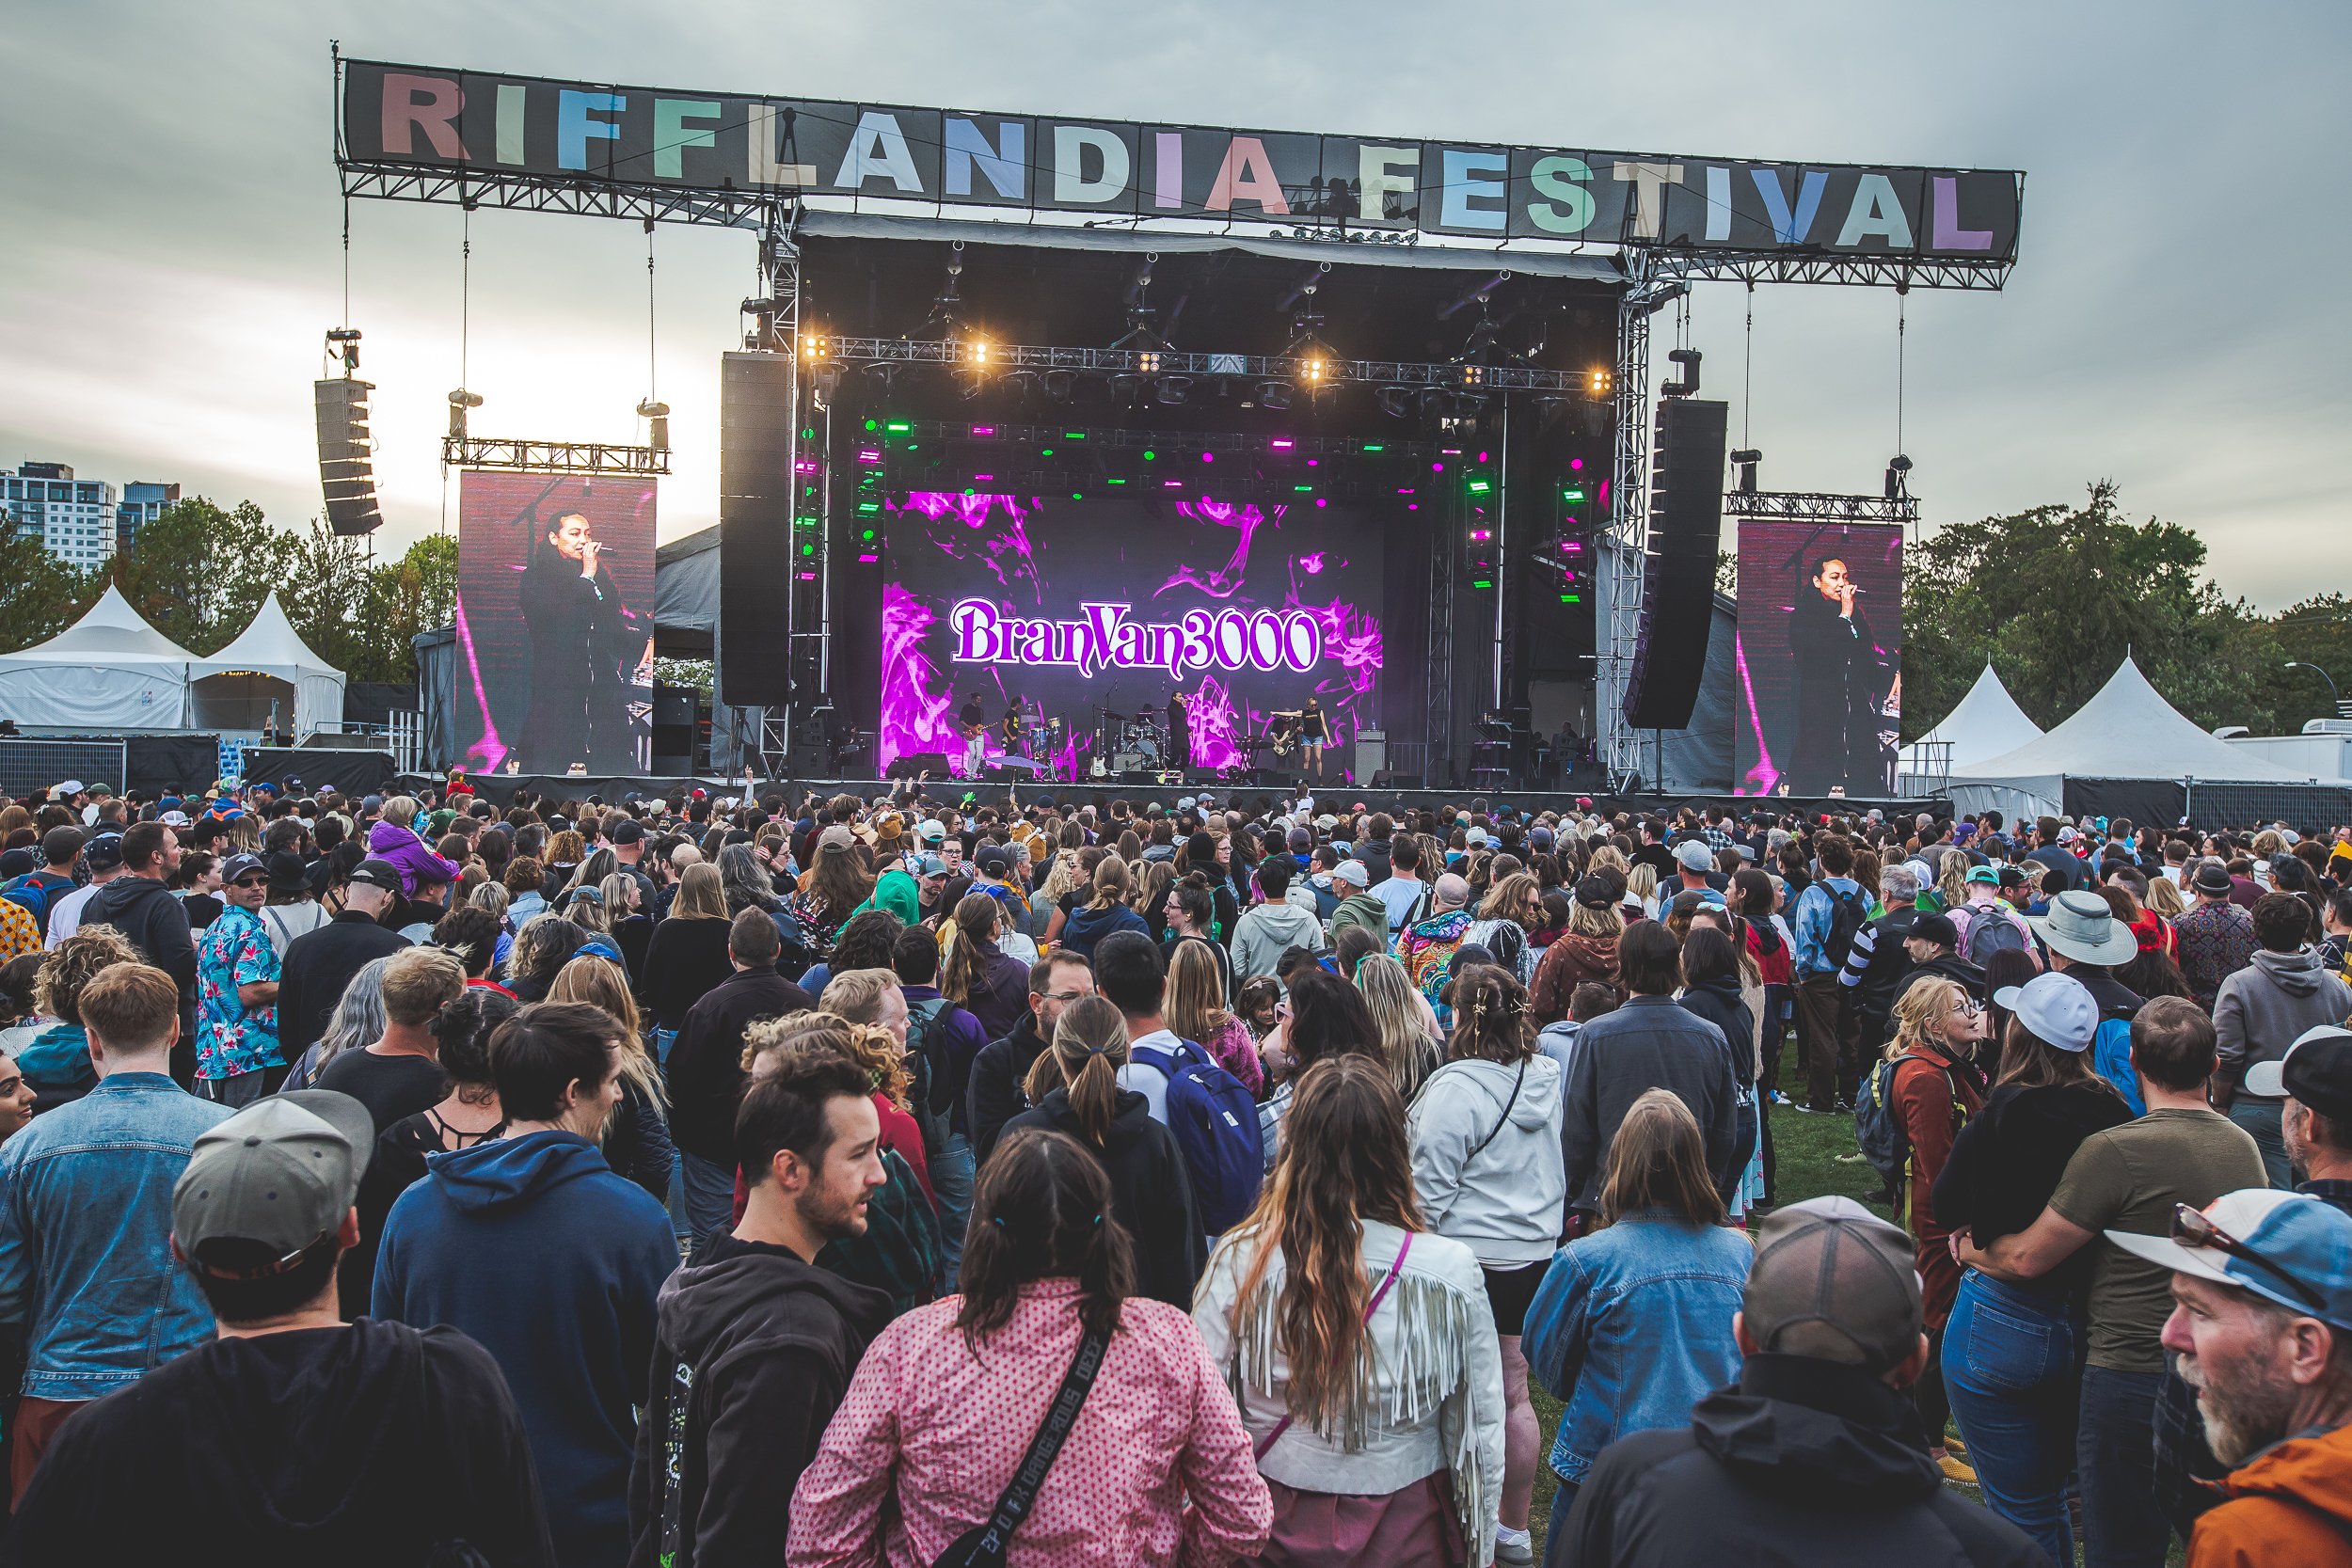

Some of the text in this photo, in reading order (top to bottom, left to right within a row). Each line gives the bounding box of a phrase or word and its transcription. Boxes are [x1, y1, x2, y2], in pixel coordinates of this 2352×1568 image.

[381, 73, 1994, 250] RIFFLANDIA FESTIVAL
[949, 597, 1321, 681] BranVan3000
[1021, 1387, 1082, 1486] DANGEROUS
